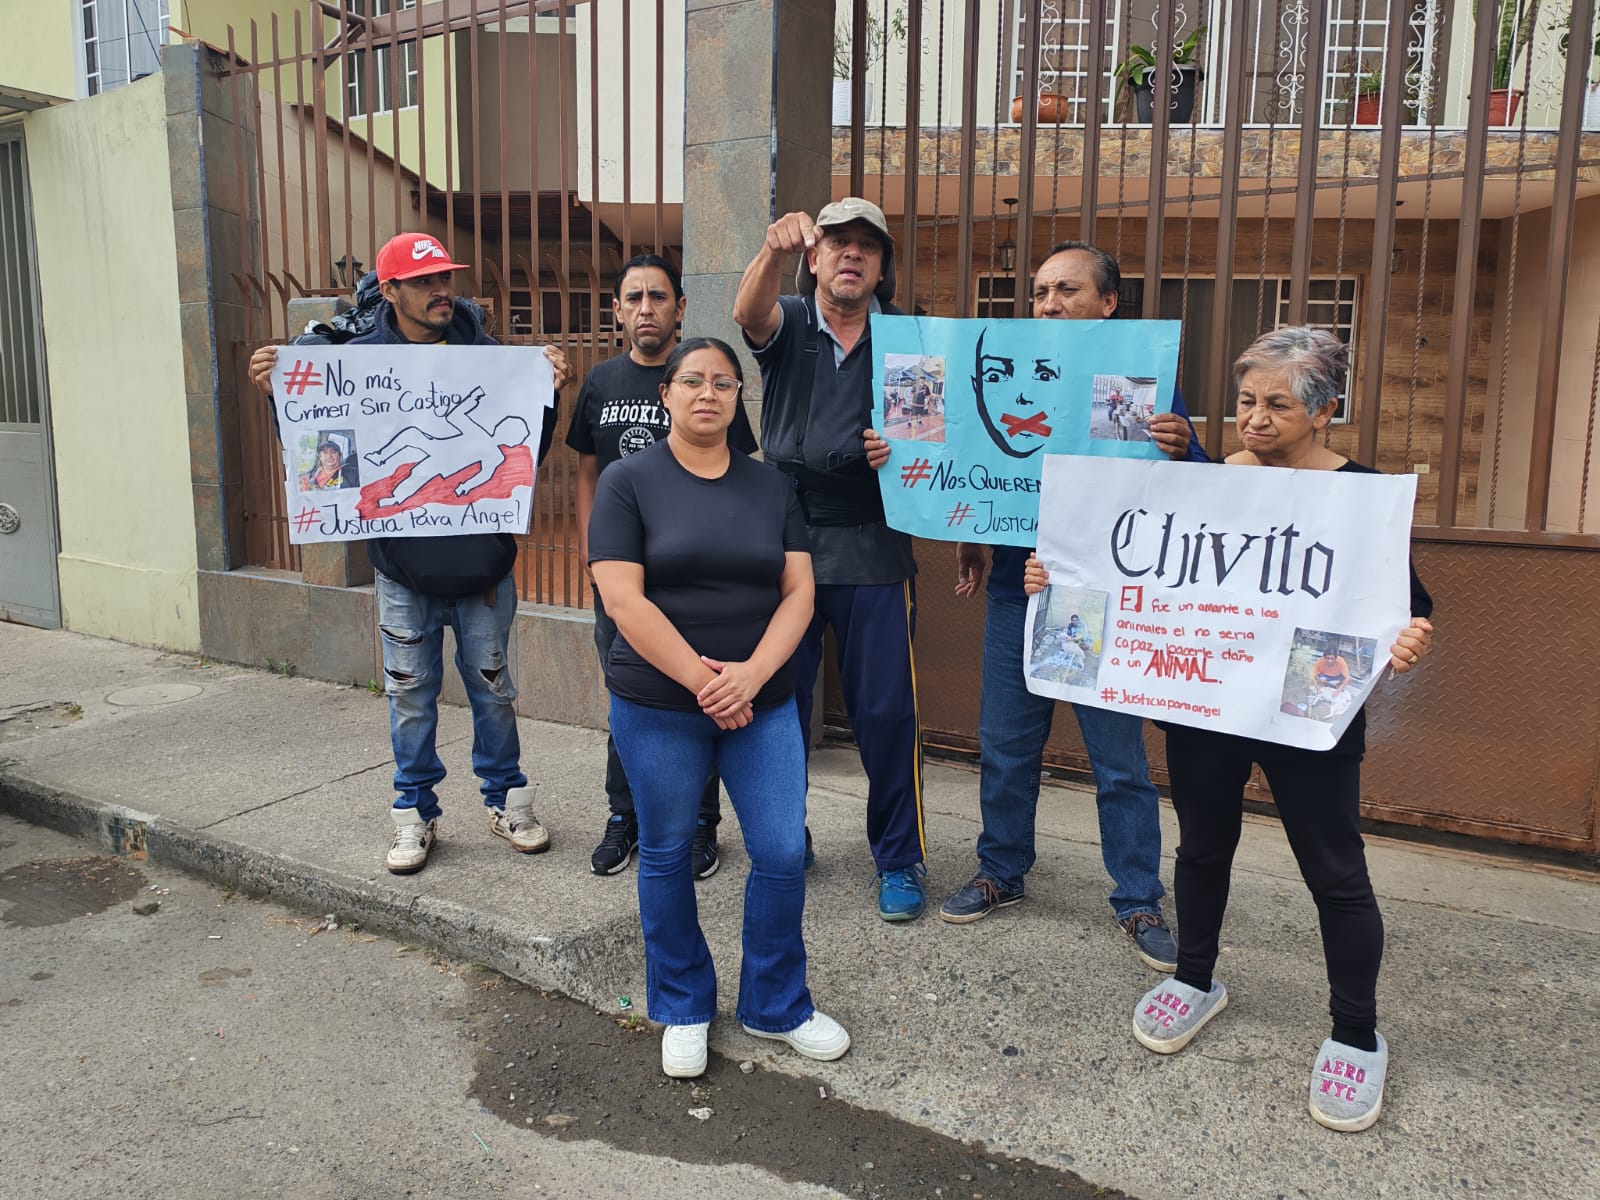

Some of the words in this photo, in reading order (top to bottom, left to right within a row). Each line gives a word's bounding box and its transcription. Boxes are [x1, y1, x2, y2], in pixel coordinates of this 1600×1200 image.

[414, 240, 433, 252] NIKE
[283, 359, 355, 397] #No
[366, 367, 402, 391] más
[285, 401, 350, 423] Crimen
[361, 397, 390, 416] Sin
[398, 381, 463, 418] Castigo
[292, 503, 403, 536] #Justicia
[410, 505, 452, 529] Para
[461, 499, 521, 531] Angel
[1110, 508, 1335, 600] Chivito
[1151, 598, 1171, 613] fue
[1178, 602, 1194, 612] un
[1244, 608, 1255, 617] a
[1116, 619, 1168, 635] animales
[1173, 626, 1185, 637] el
[1194, 627, 1211, 638] no
[1218, 630, 1256, 641] seria
[1110, 656, 1121, 667] a
[1127, 660, 1142, 668] un
[1221, 648, 1254, 664] daño
[1143, 1003, 1175, 1028] NYC
[1152, 990, 1191, 1017] AERO
[1320, 1057, 1366, 1084] AERO
[1319, 1078, 1358, 1102] NYC
